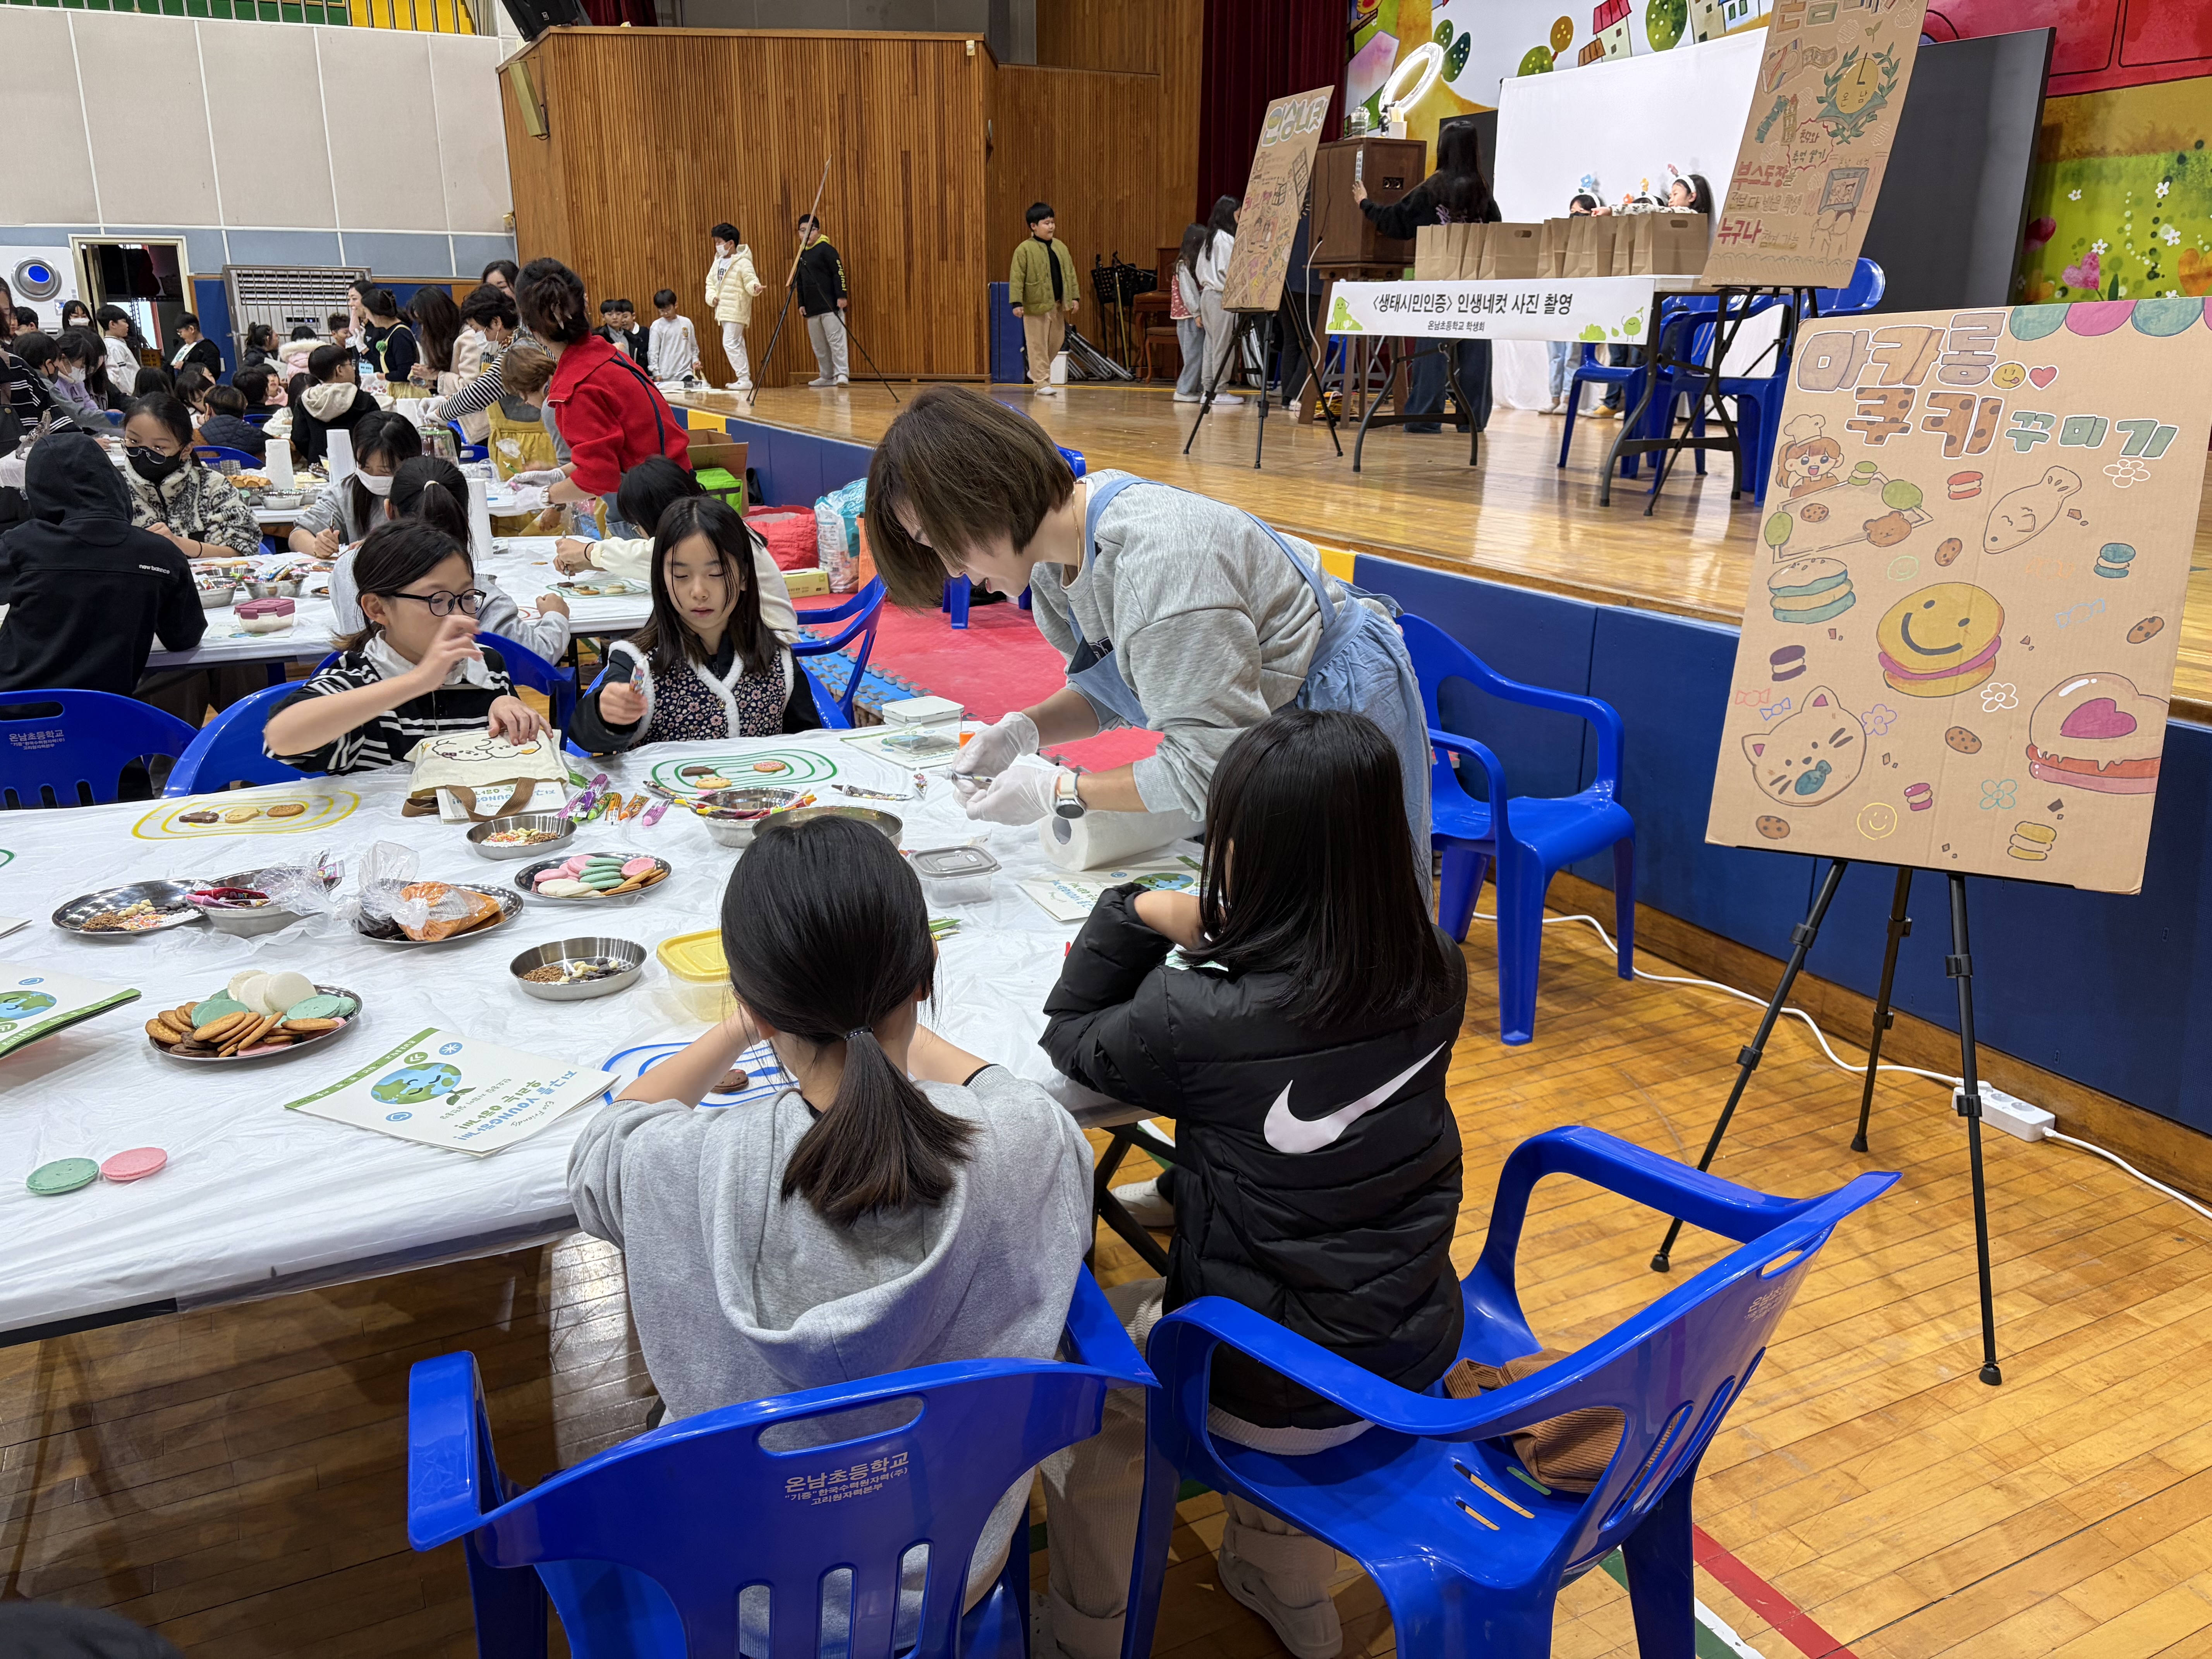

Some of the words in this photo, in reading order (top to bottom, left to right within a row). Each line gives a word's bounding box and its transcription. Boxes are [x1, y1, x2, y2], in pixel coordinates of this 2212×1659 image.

[1732, 161, 1797, 191] 부스도장을
[1729, 192, 1748, 211] 전부
[1748, 196, 1760, 208] 다
[1717, 217, 1762, 245] 누구나
[1457, 293, 1508, 314] 인생네컷
[1511, 294, 1539, 315] 사진
[1544, 293, 1573, 315] 촬영
[1427, 321, 1464, 331] 온남초등학교
[1466, 322, 1485, 332] 학생회
[1796, 311, 2008, 392] 마카롱
[1845, 385, 2004, 459] 쿠키
[2004, 410, 2179, 460] 꾸미기
[9, 730, 64, 742] 온남초등학교
[501, 1080, 542, 1103] 우리는
[536, 1070, 577, 1095] 지구를
[542, 1101, 555, 1110] Eco
[453, 1097, 540, 1140] YOUNG하게!
[510, 1110, 545, 1127] Friendly
[785, 1451, 909, 1493] 온남초등학교
[811, 1483, 883, 1506] 고리원자력본부
